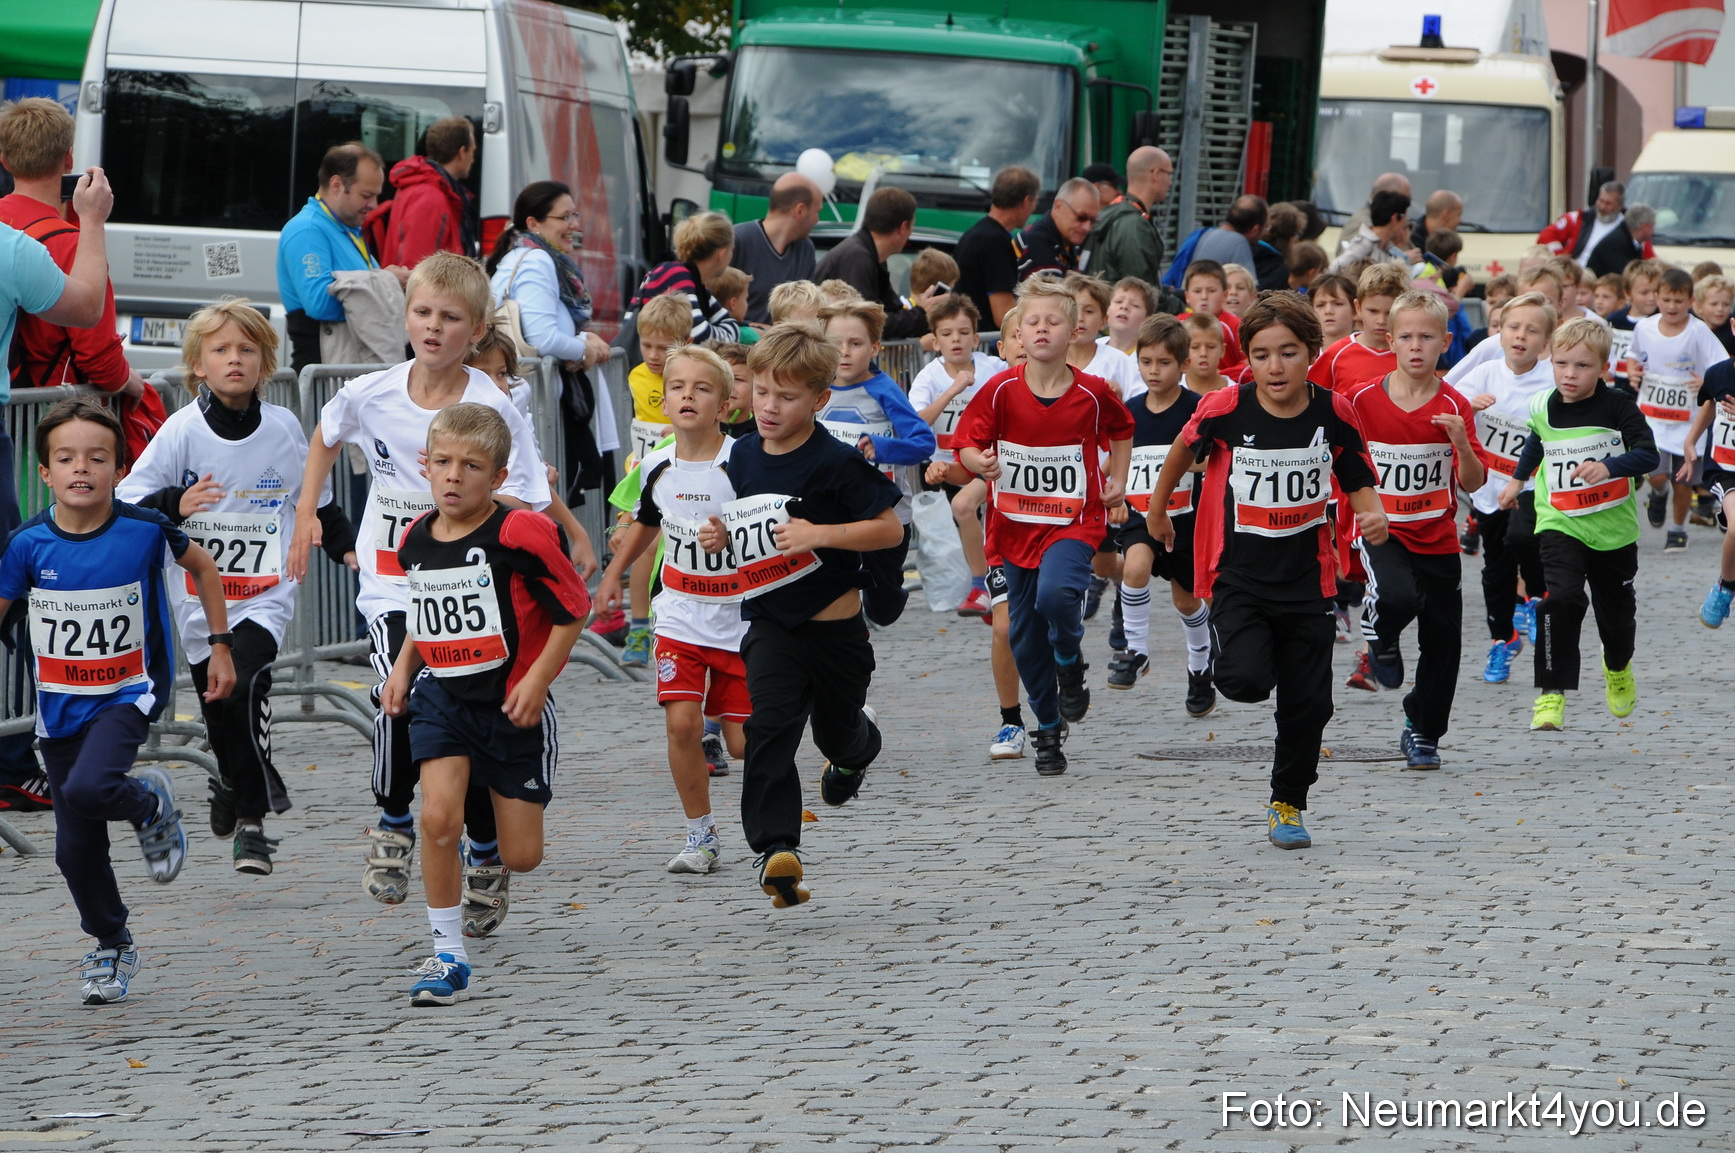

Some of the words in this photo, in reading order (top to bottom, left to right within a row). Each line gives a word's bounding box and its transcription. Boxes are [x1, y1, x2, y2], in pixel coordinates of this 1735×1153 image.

[144, 321, 165, 339] NM
[1647, 386, 1688, 407] 7086
[1485, 424, 1526, 458] 712
[1567, 442, 1608, 455] Neumarkt
[1000, 448, 1026, 460] PARTL
[1028, 454, 1071, 463] Neumarkt
[1236, 456, 1268, 468] PARTL
[1270, 457, 1318, 468] Neumarkt
[1370, 448, 1398, 460] PARTL
[1400, 450, 1440, 460] Neumarkt
[373, 458, 396, 472] ARTL
[1006, 462, 1076, 494] 7090
[1376, 460, 1442, 492] 7094
[1245, 468, 1321, 503] 7103
[376, 494, 402, 510] PARTL
[1018, 498, 1064, 514] Vincent
[1396, 500, 1423, 512] Luca
[1576, 492, 1600, 505] Tim
[737, 502, 772, 520] Neumarkt
[1269, 512, 1300, 526] Nino
[180, 521, 211, 531] PARTL
[213, 522, 262, 533] Neumarkt
[662, 518, 686, 536] PARTL
[728, 517, 780, 562] 276
[744, 560, 791, 585] Tommy
[424, 579, 473, 592] Neumarkt
[682, 578, 729, 593] Fabian
[30, 598, 62, 612] PARTL
[65, 598, 122, 612] Neumarkt
[412, 593, 486, 636] 7085
[41, 615, 132, 656] 7242
[430, 646, 471, 664] Kilian
[65, 665, 116, 682] Marco
